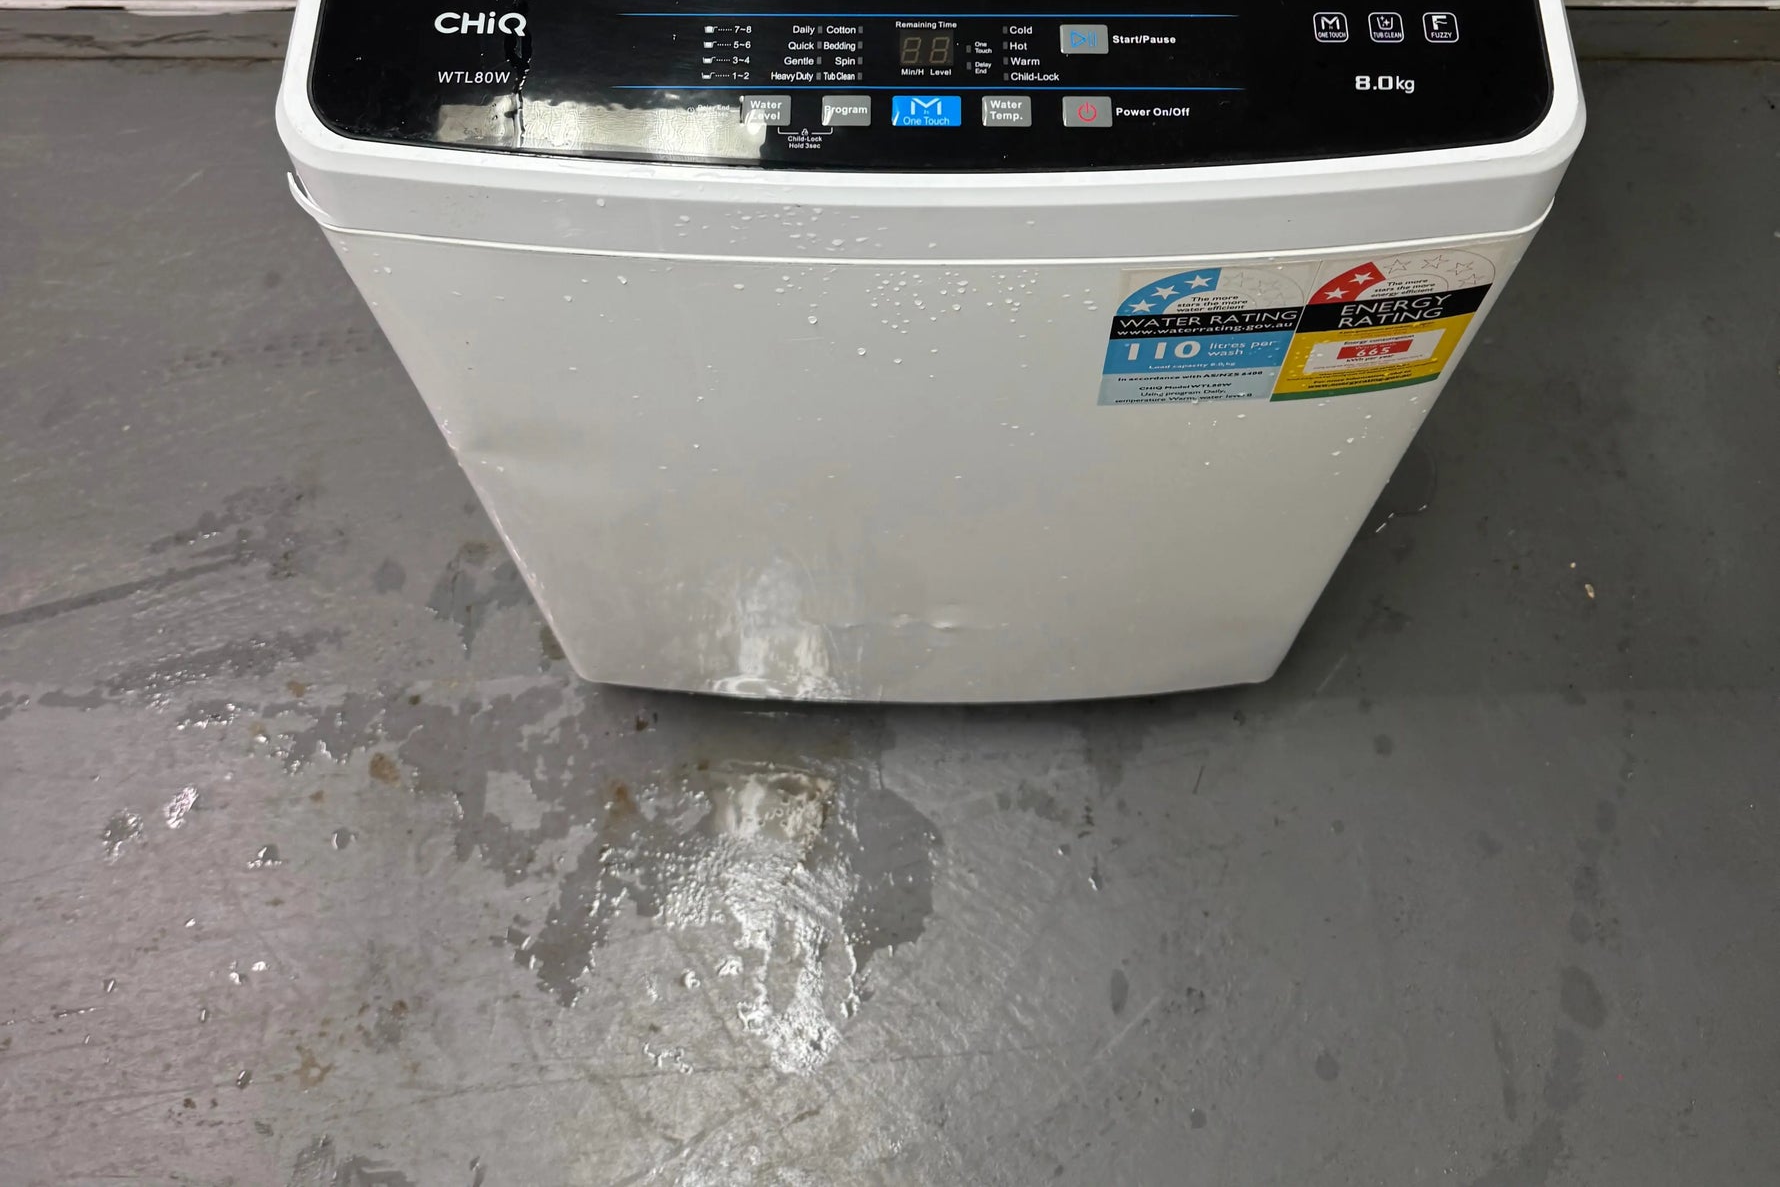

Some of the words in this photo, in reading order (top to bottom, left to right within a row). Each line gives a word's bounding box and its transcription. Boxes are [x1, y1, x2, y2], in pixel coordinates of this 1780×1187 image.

[434, 11, 527, 37] CHiQ
[895, 21, 937, 30] Remaining
[938, 21, 958, 29] Time
[792, 25, 816, 35] Daily
[826, 25, 857, 35] Cotton
[1010, 25, 1033, 35] Cold
[1112, 34, 1177, 45] Start/Pause
[788, 41, 815, 51] Quick
[823, 41, 856, 51] Bedding
[1010, 41, 1028, 50] Hot
[784, 56, 815, 66] Gentle
[835, 56, 856, 67] Spin
[1010, 57, 1041, 66] Warm
[771, 72, 796, 82] Heavy
[796, 72, 814, 82] Duty
[823, 72, 836, 81] Tub
[836, 72, 856, 81] Clean
[901, 68, 925, 76] Min/H
[930, 68, 952, 77] Level
[1011, 72, 1060, 82] Child-Lock
[438, 71, 511, 84] WTL80W
[750, 100, 783, 109] Water
[990, 100, 1023, 109] Water
[752, 111, 781, 120] Level
[824, 105, 868, 116] Program
[1115, 107, 1153, 117] Power
[1156, 107, 1191, 117] On/Off
[903, 116, 922, 126] One
[923, 116, 950, 126] Touch
[990, 111, 1023, 121] Temp.
[1341, 294, 1452, 316] ENERGY
[1119, 316, 1201, 329] WATER
[1209, 310, 1298, 325] RATING
[1337, 307, 1444, 329] RATING
[1117, 321, 1293, 336] www.waterrating.gov.au
[1209, 341, 1246, 350] litres
[1251, 340, 1276, 350] per
[1127, 340, 1201, 361] 110
[1208, 349, 1244, 357] wash
[1356, 346, 1391, 357] 665
